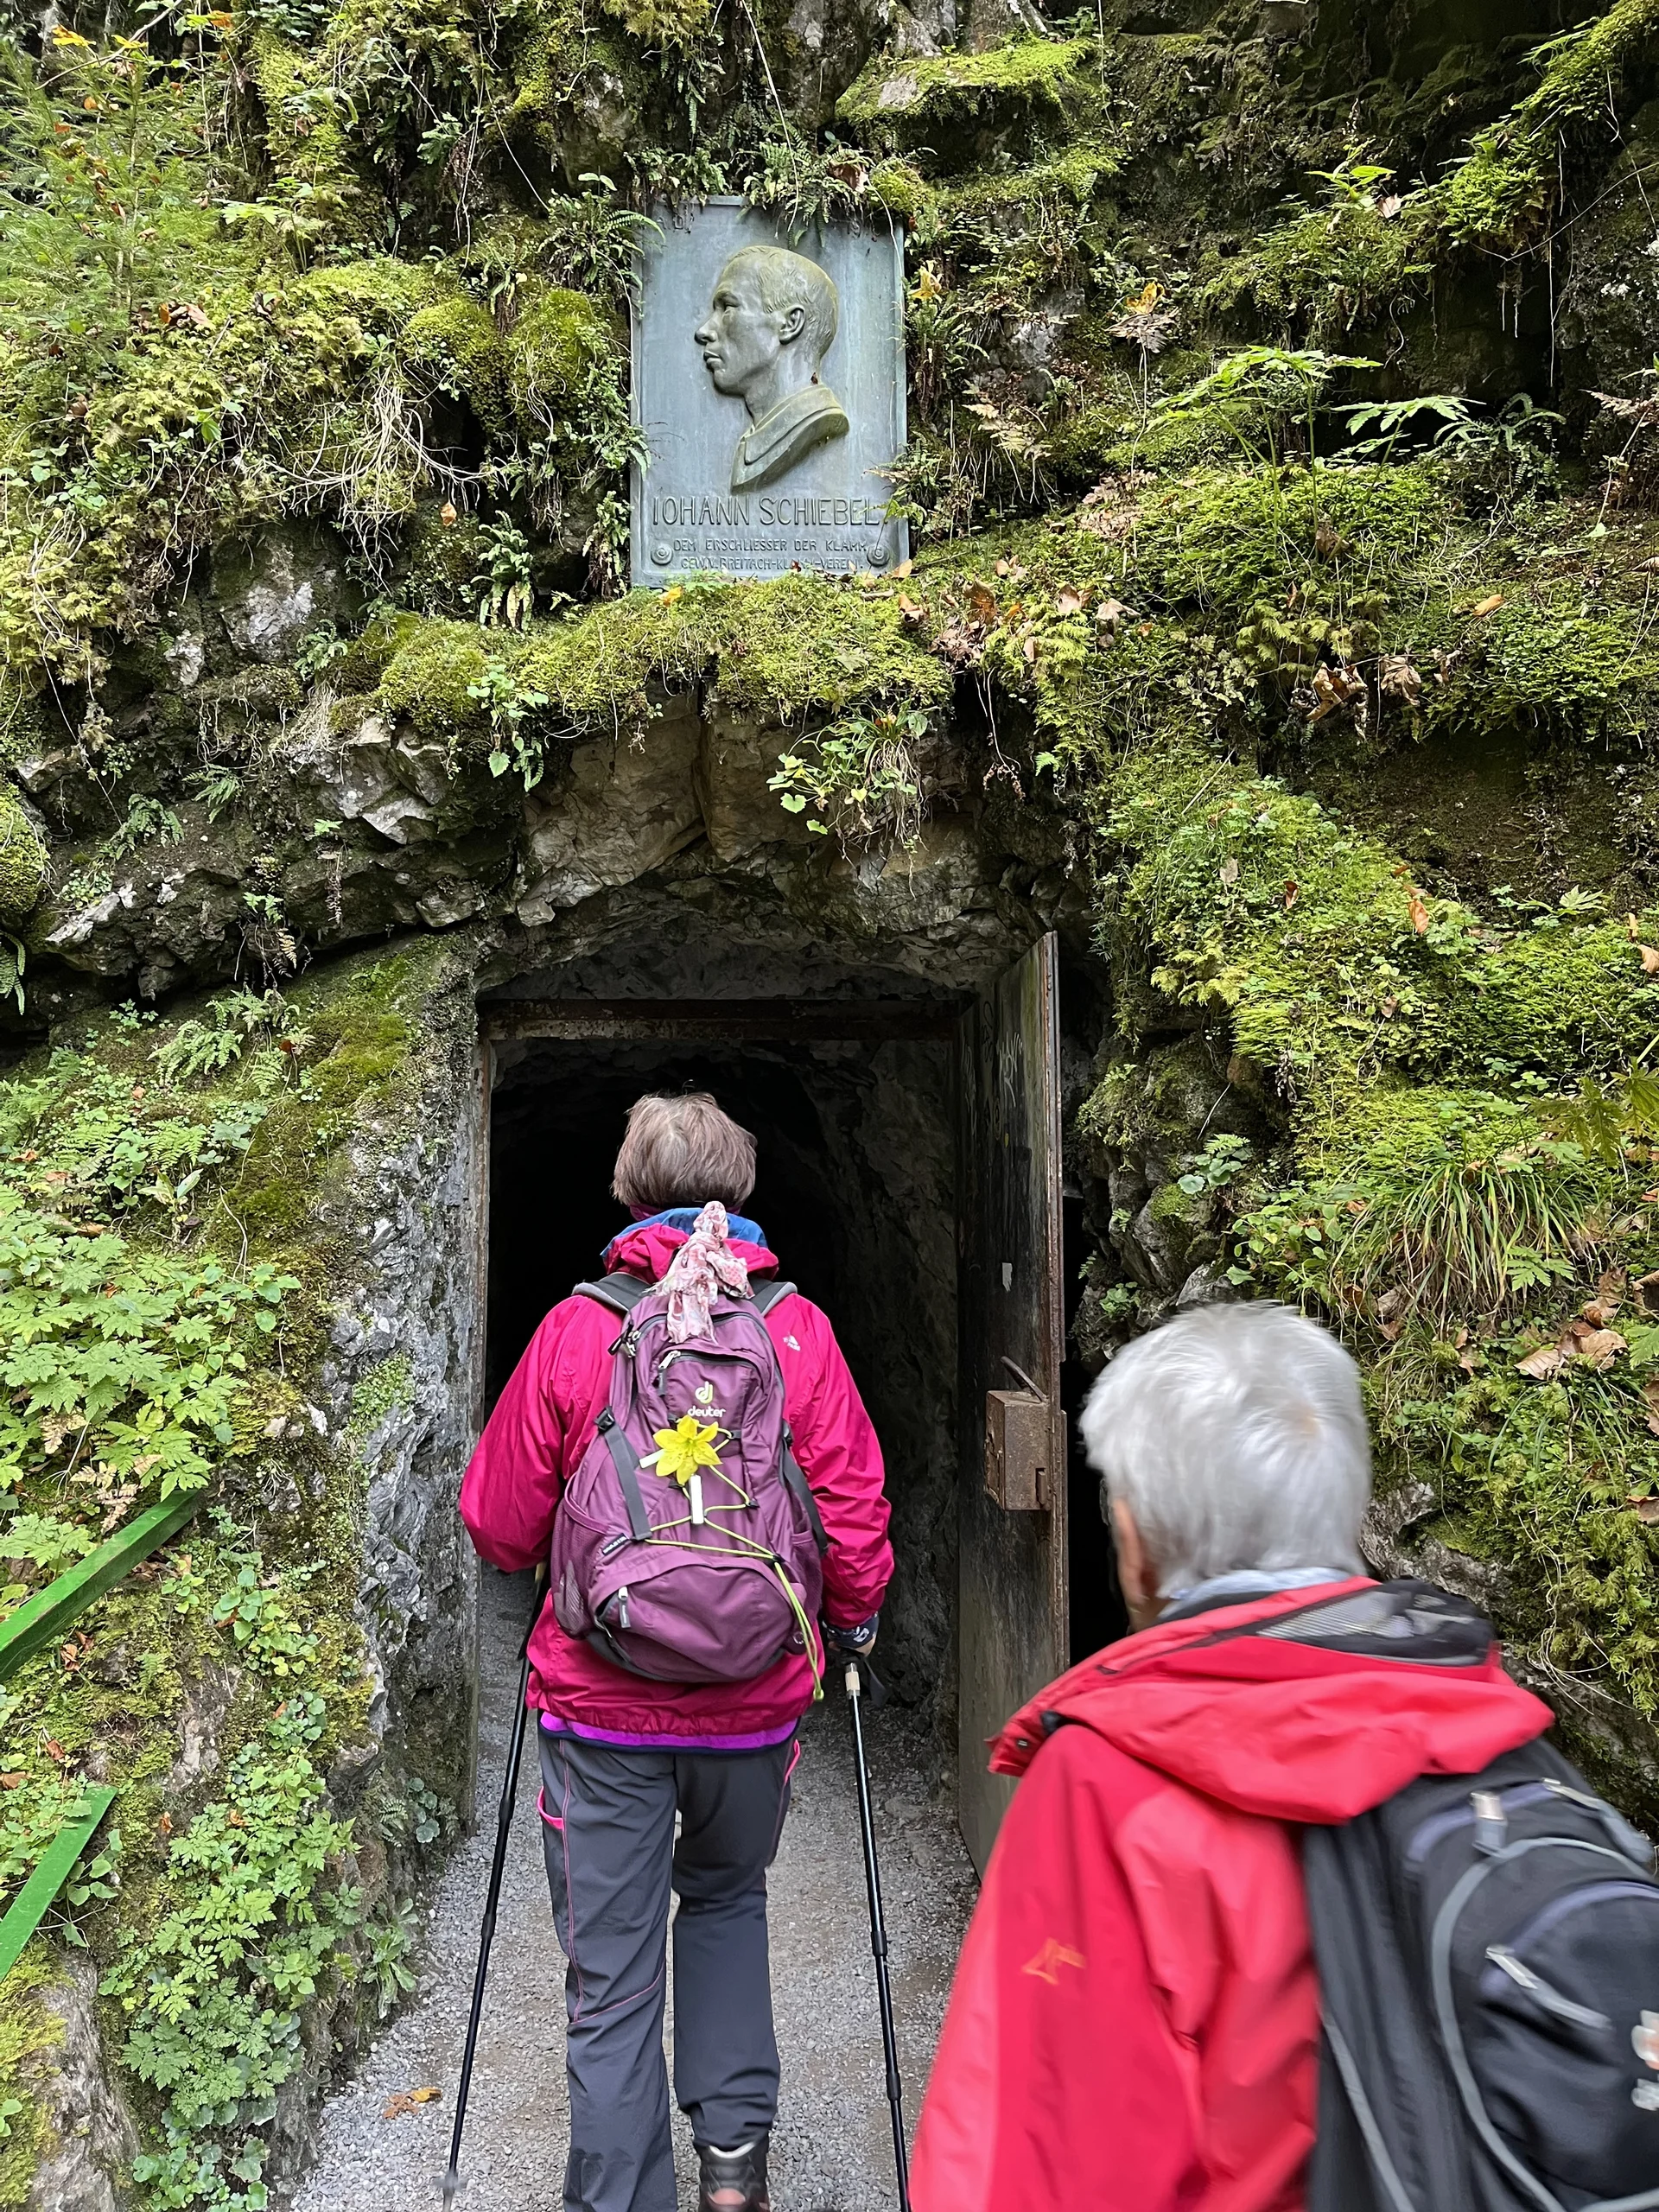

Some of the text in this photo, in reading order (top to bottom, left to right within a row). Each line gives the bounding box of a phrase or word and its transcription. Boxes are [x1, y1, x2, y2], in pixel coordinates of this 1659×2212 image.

[652, 495, 750, 526] IOHANN
[673, 538, 696, 551] DEM
[705, 538, 788, 551] ERSCHLIESSER
[793, 539, 817, 551] DER
[687, 1405, 727, 1418] deuter
